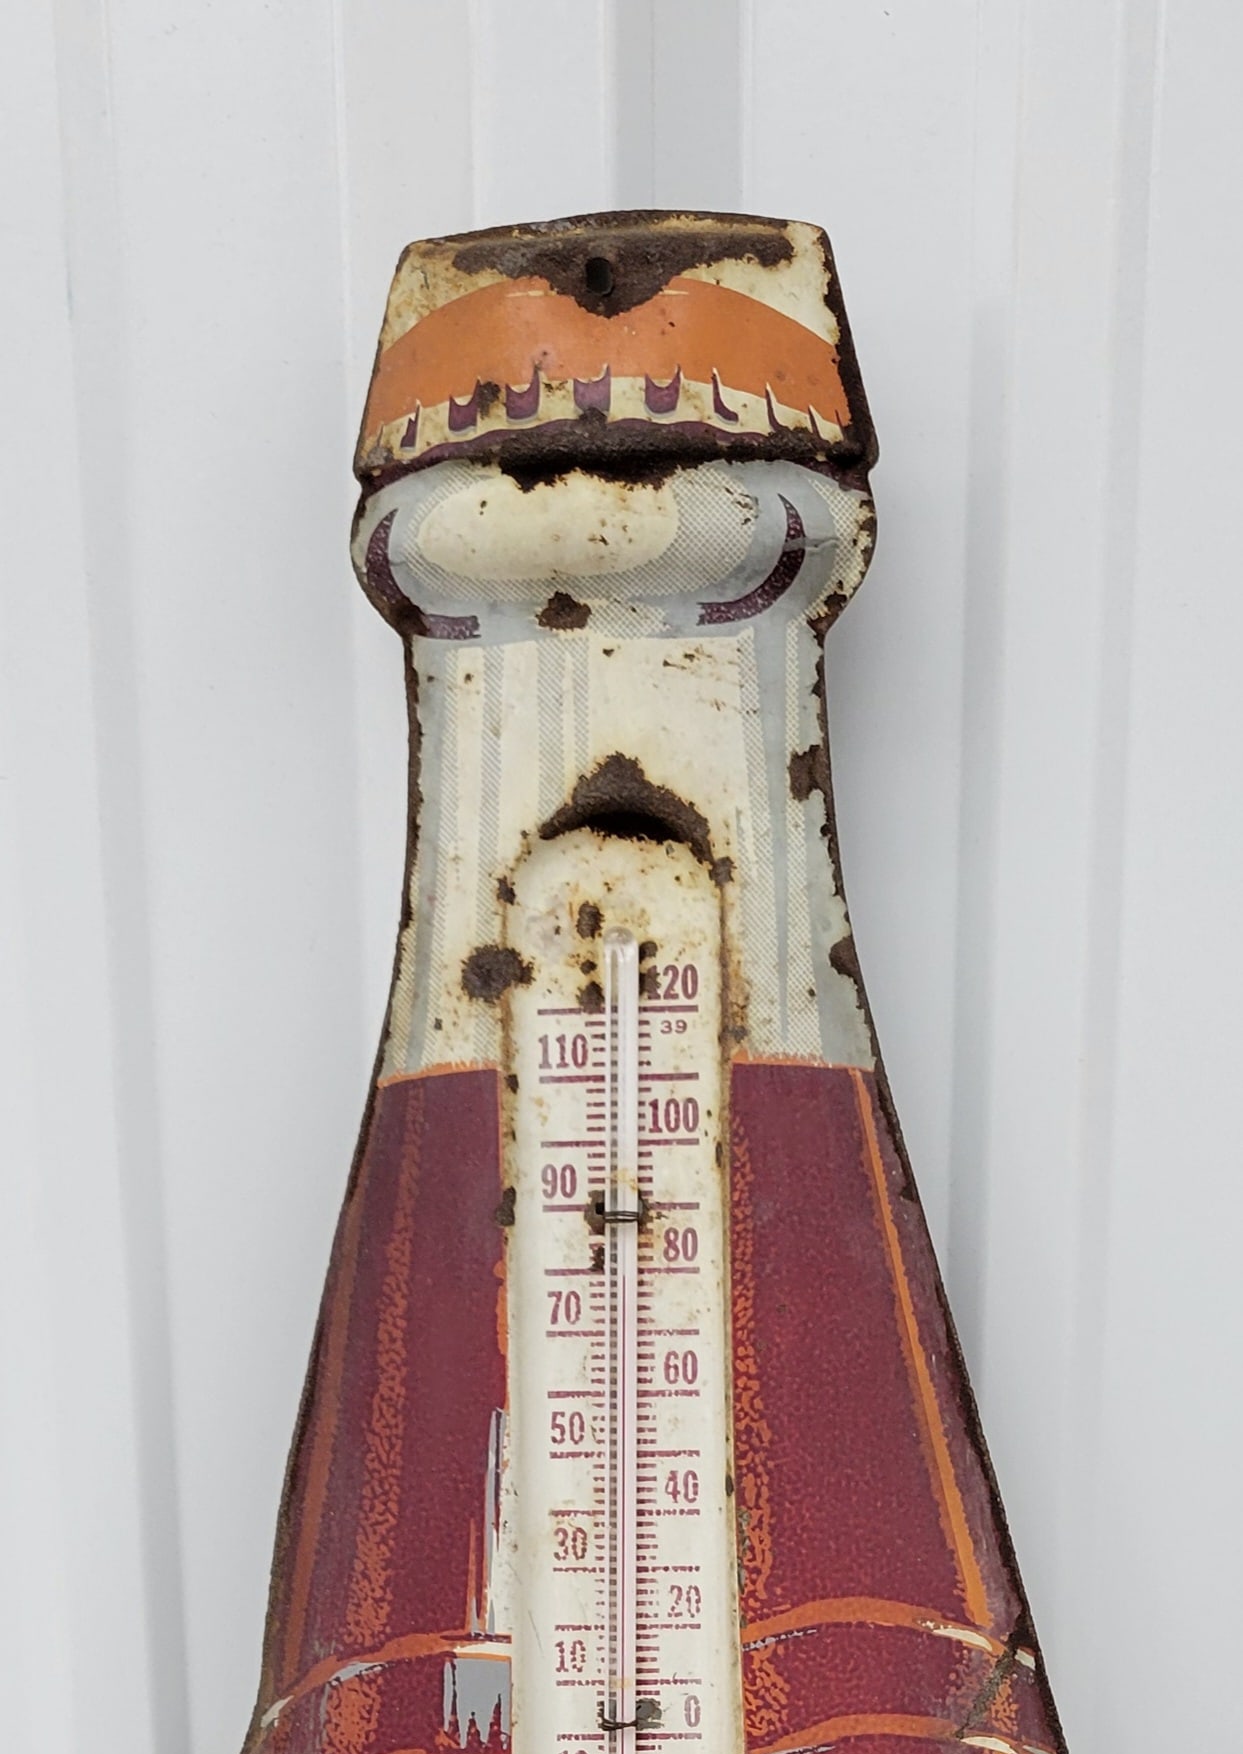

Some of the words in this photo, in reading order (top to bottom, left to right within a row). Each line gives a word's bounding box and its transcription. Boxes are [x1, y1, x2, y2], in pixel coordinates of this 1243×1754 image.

[646, 963, 699, 1001] 120
[660, 1019, 688, 1035] 39
[538, 1033, 589, 1069] 110
[648, 1097, 699, 1133] 100
[541, 1163, 577, 1199] 90
[663, 1227, 698, 1262] 80
[548, 1290, 582, 1325] 70
[663, 1350, 698, 1385] 60
[550, 1411, 585, 1445] 50
[664, 1470, 699, 1504] 40
[553, 1527, 588, 1561] 30
[667, 1585, 701, 1618] 20
[556, 1640, 587, 1673] 10
[684, 1695, 701, 1728] 0
